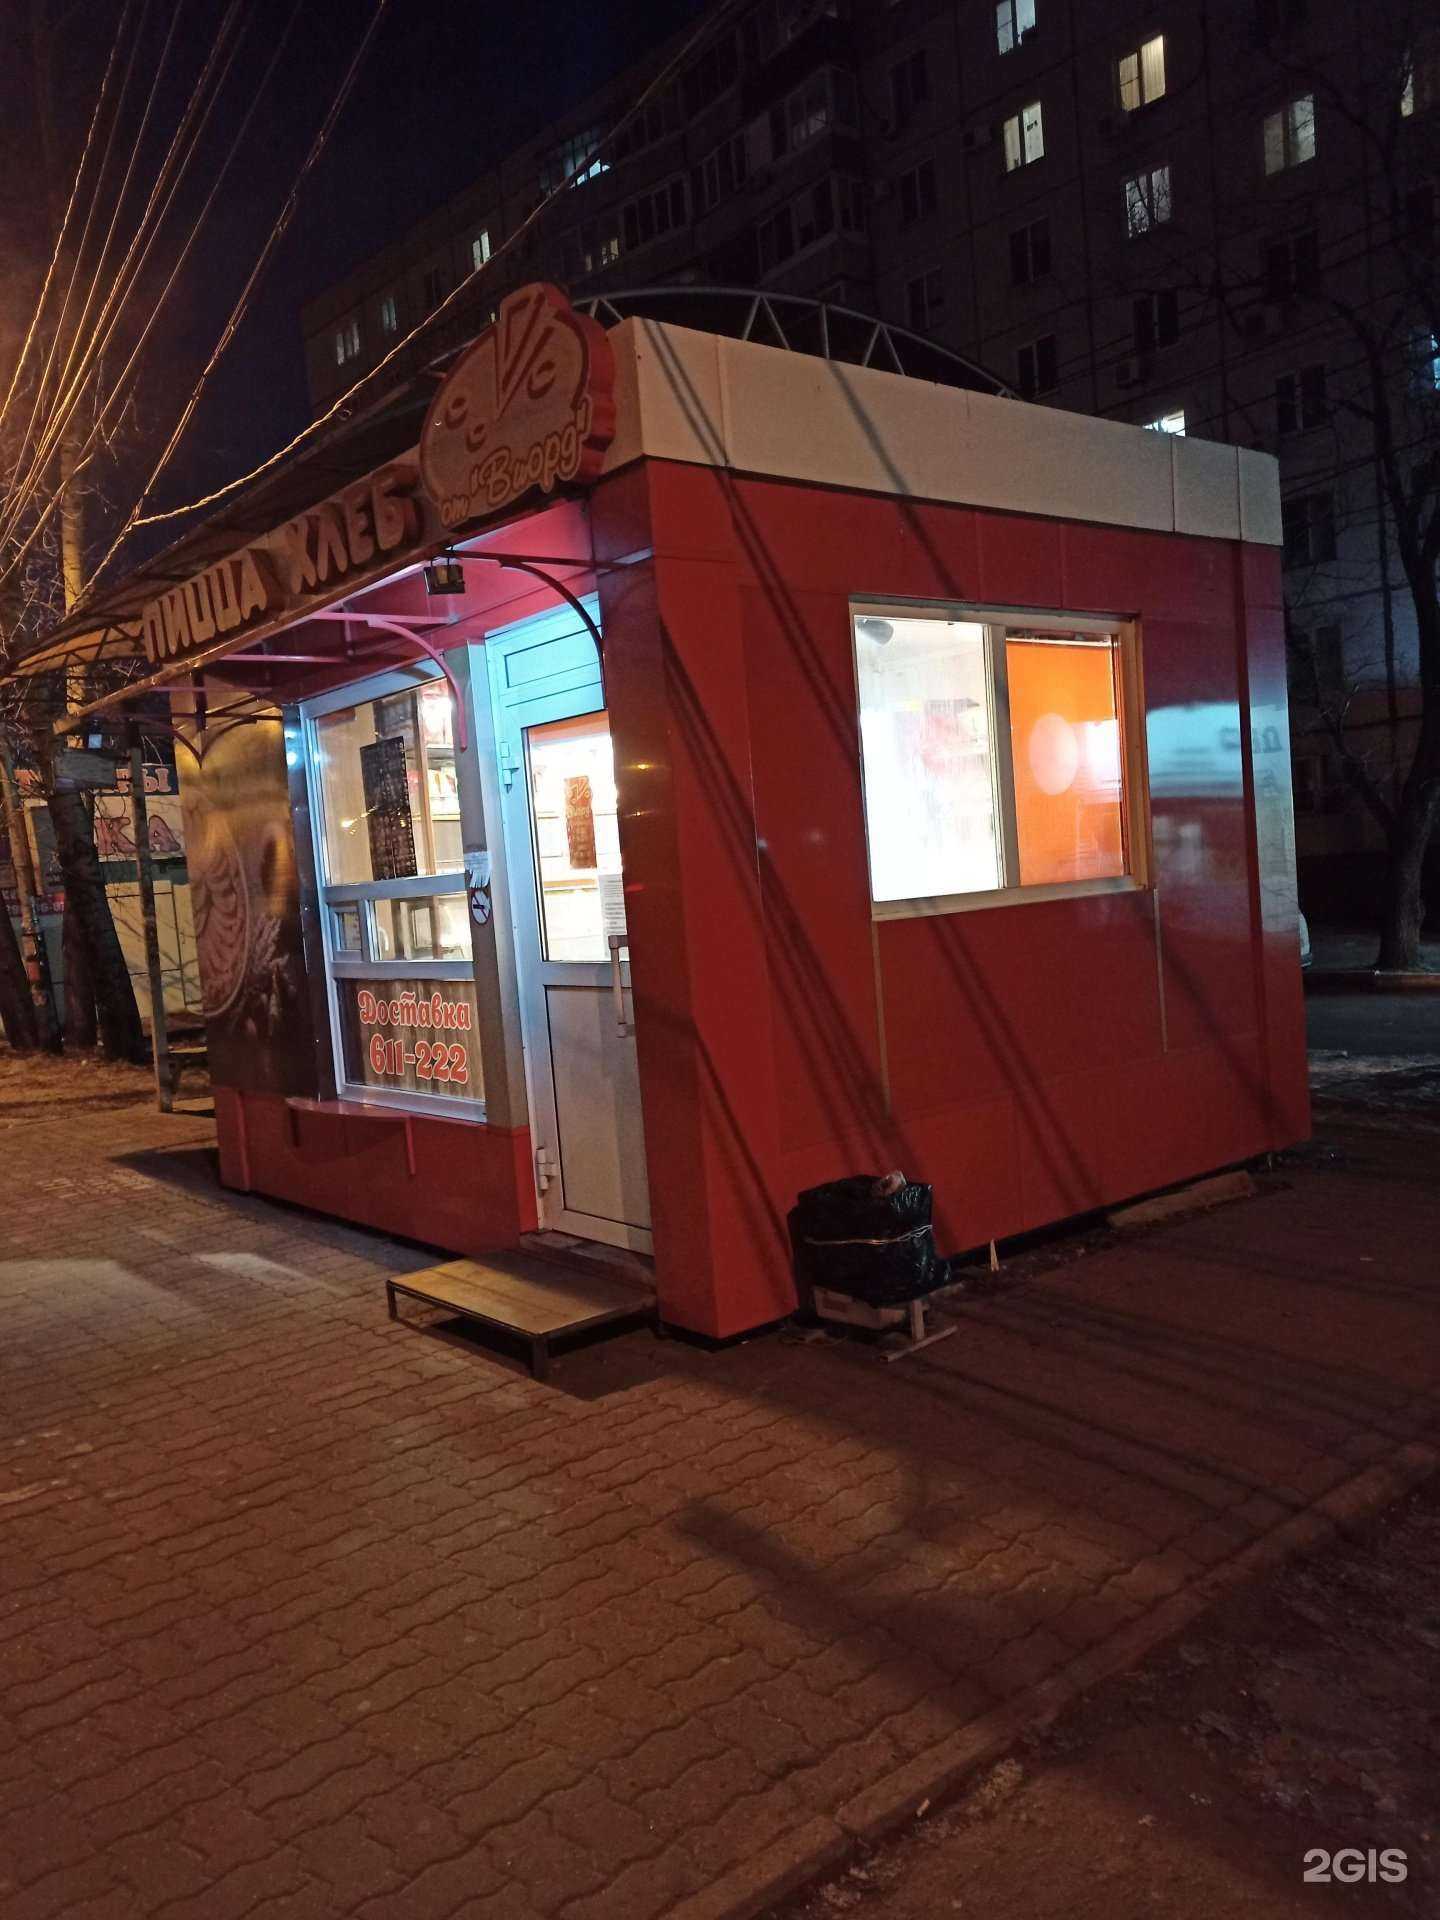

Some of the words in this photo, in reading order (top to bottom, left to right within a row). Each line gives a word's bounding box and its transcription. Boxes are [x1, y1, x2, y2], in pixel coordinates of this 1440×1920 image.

[142, 549, 271, 663] ПИЦЦА
[283, 476, 410, 594] ХЛЕБ
[358, 990, 471, 1030] Доставка
[370, 1033, 468, 1084] 611-222
